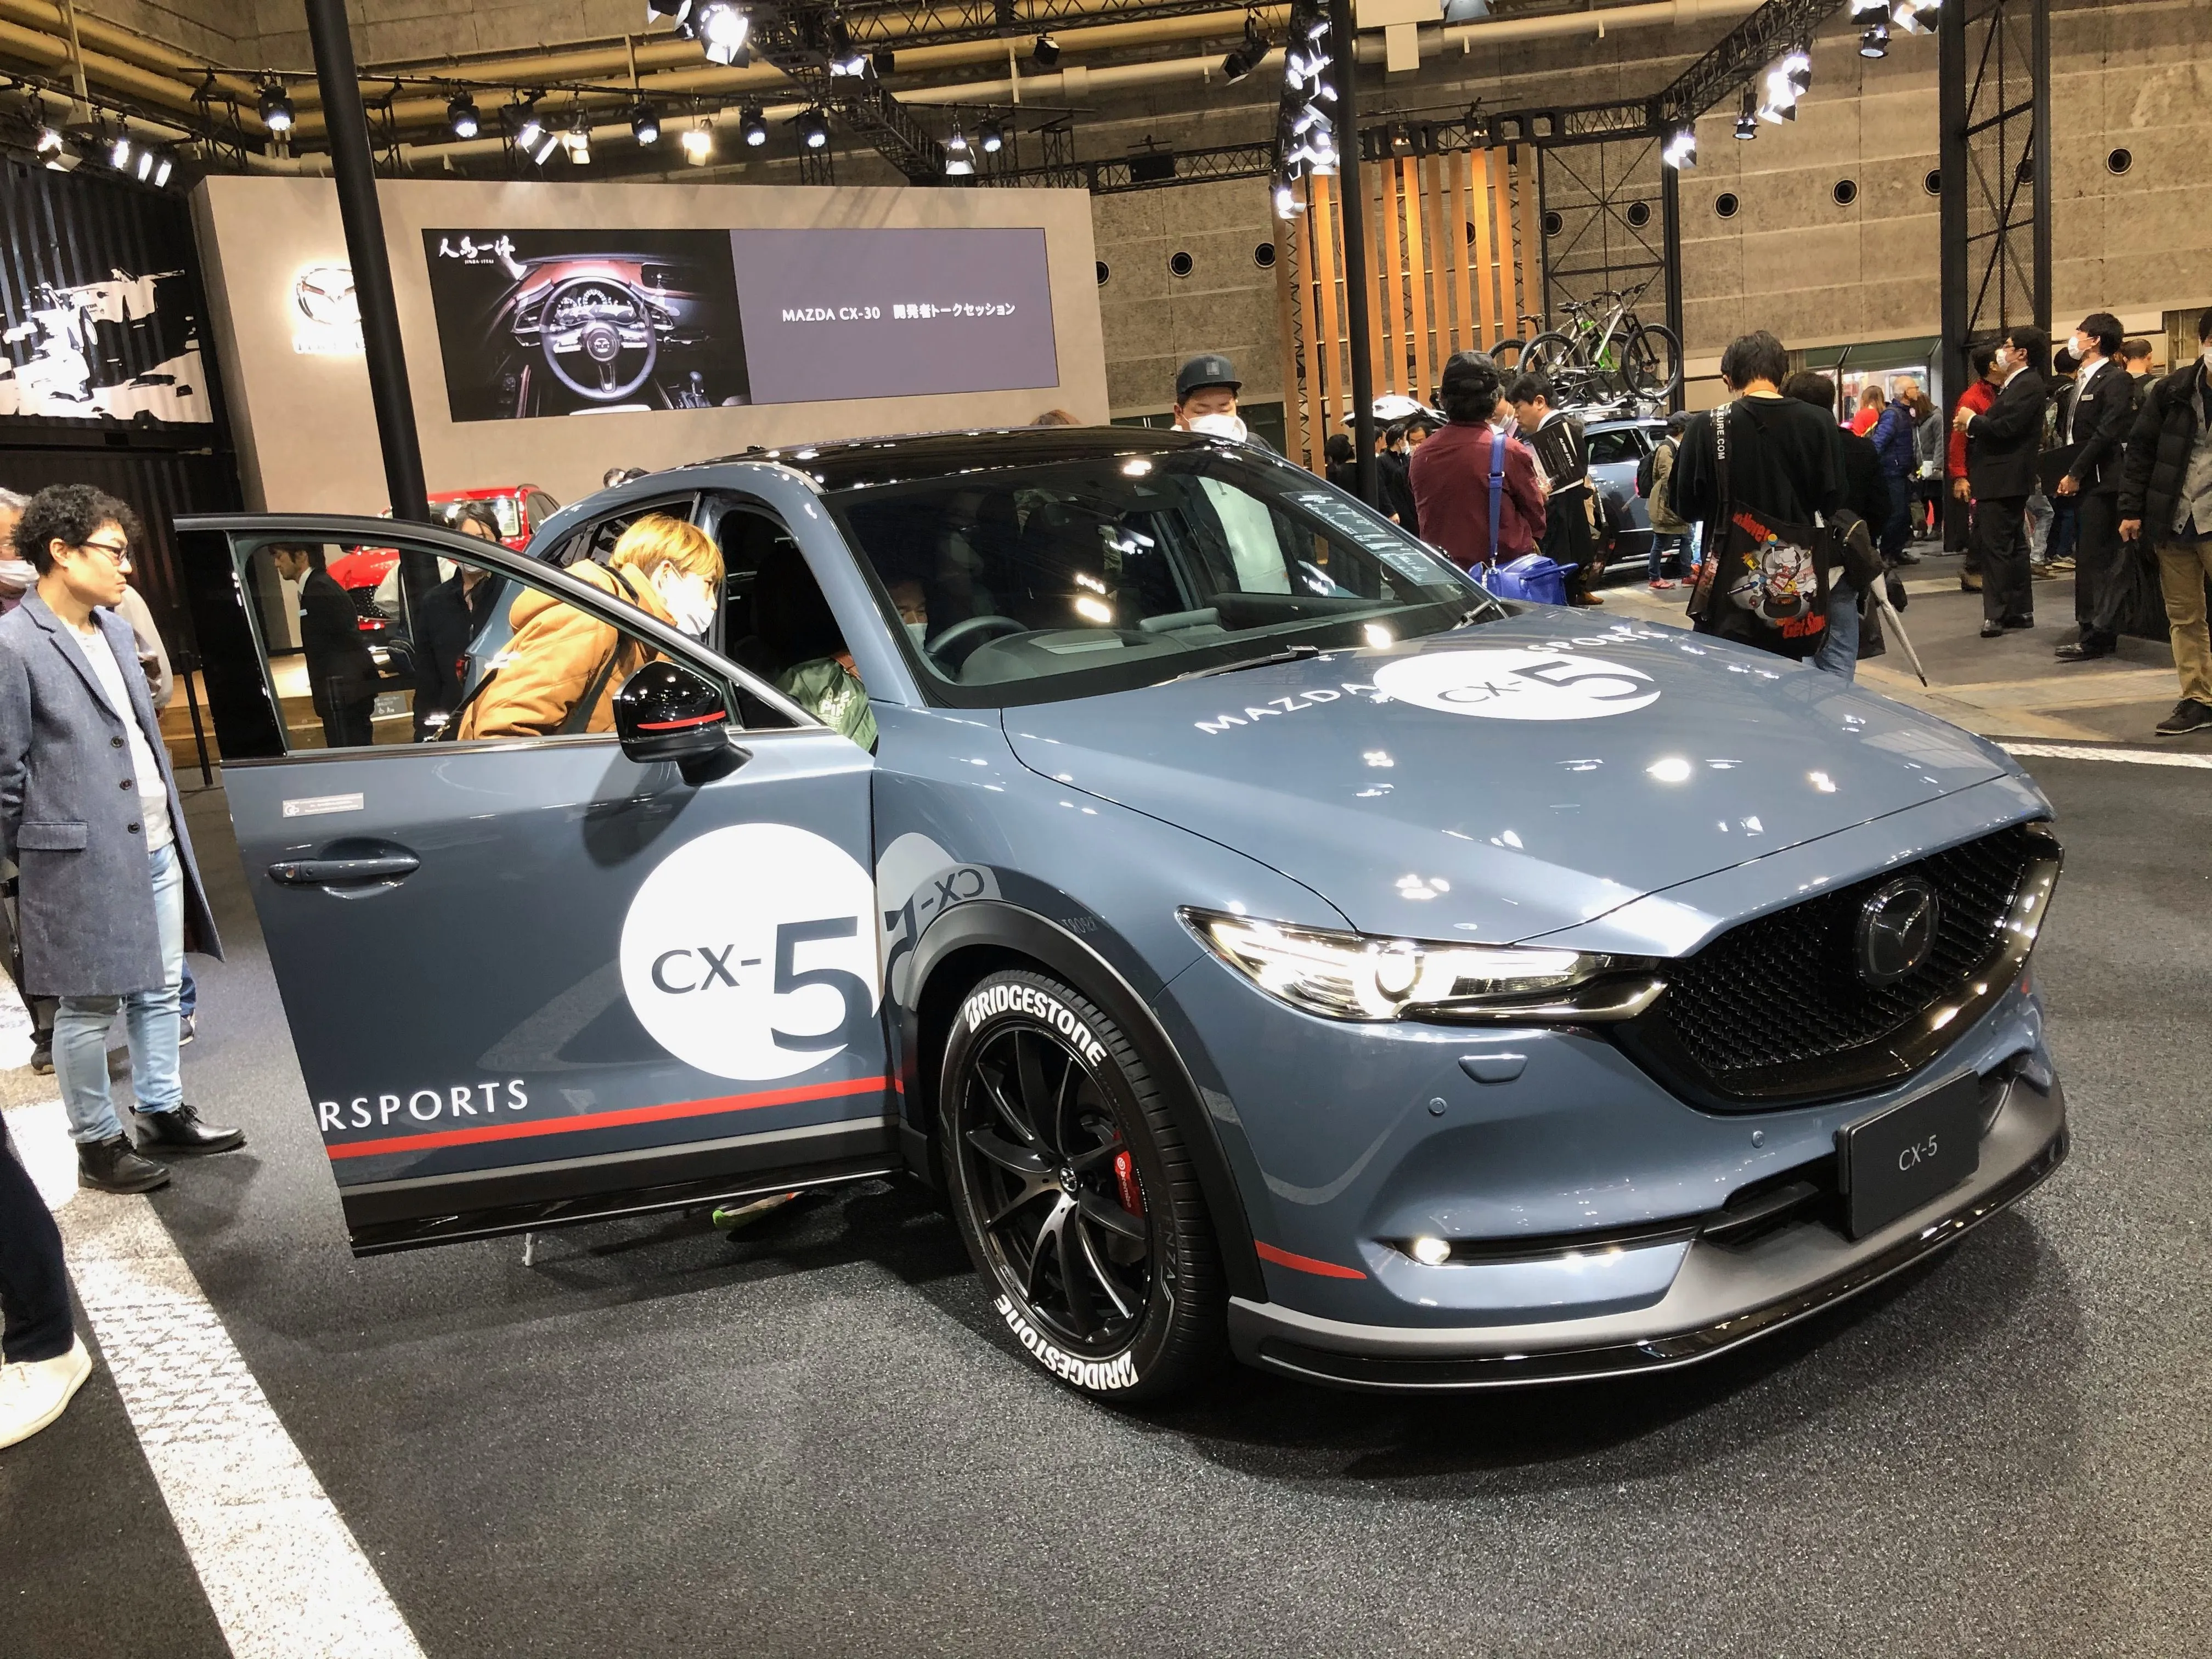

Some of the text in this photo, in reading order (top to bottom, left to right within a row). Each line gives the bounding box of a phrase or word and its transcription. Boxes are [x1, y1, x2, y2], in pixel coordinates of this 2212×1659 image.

[782, 302, 1016, 322] MAZDA CX-30 開発者トークセッション
[1194, 629, 1669, 735] MAZDA SPORTS
[1437, 661, 1659, 701] CX-5
[651, 916, 875, 1052] CX-5
[964, 985, 1107, 1067] BRIDGESTONE
[319, 1079, 528, 1131] RSPORTS
[1899, 1134, 1938, 1171] CX-5
[993, 1294, 1139, 1390] BRIDGESTONE
